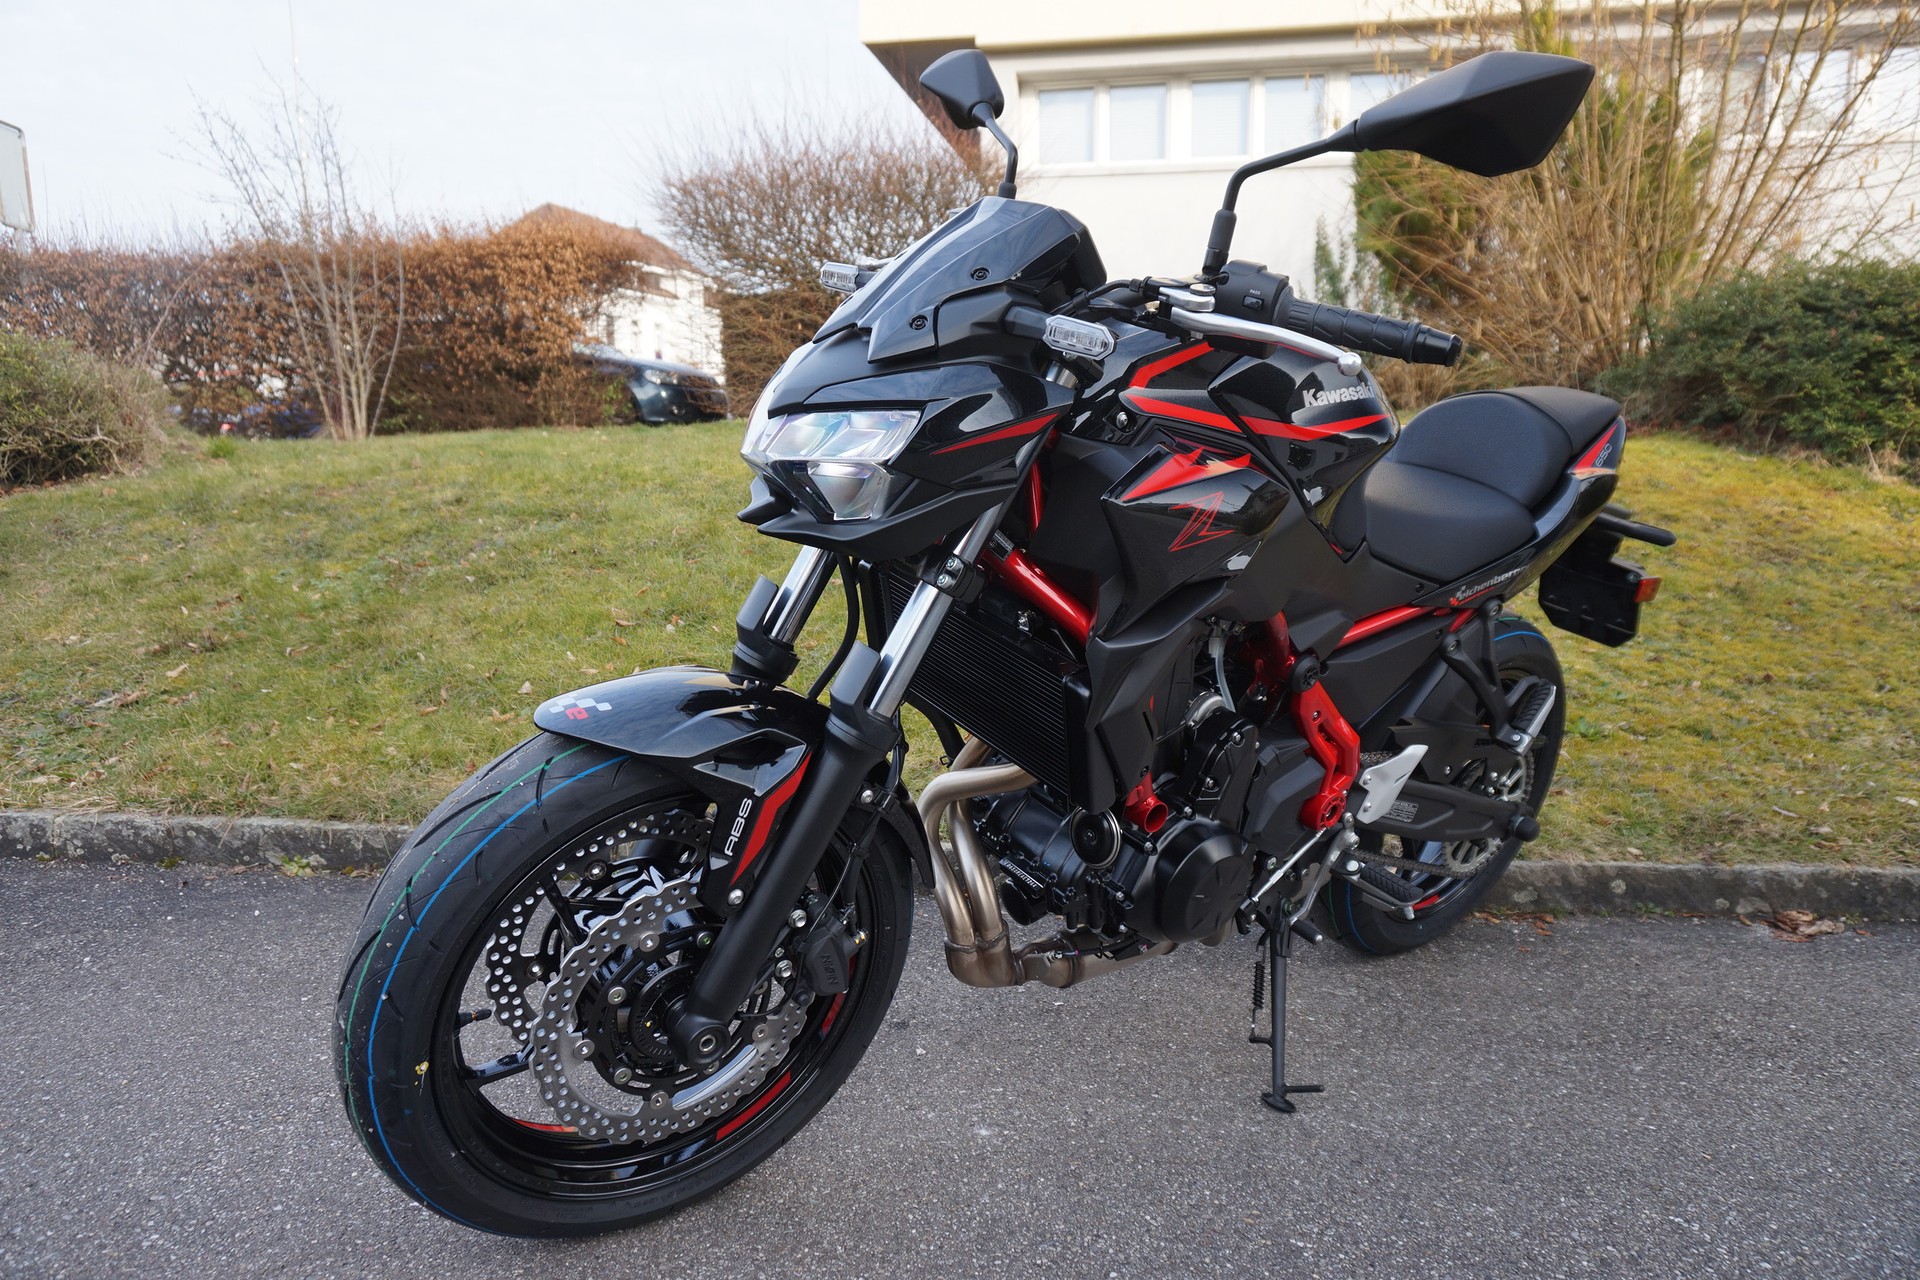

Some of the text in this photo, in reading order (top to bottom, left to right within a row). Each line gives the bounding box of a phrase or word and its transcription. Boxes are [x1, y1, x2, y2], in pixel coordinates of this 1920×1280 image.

[1302, 382, 1375, 408] Kawasaki
[1595, 443, 1613, 467] 650
[1460, 564, 1529, 600] eichenber
[724, 797, 753, 856] ABS
